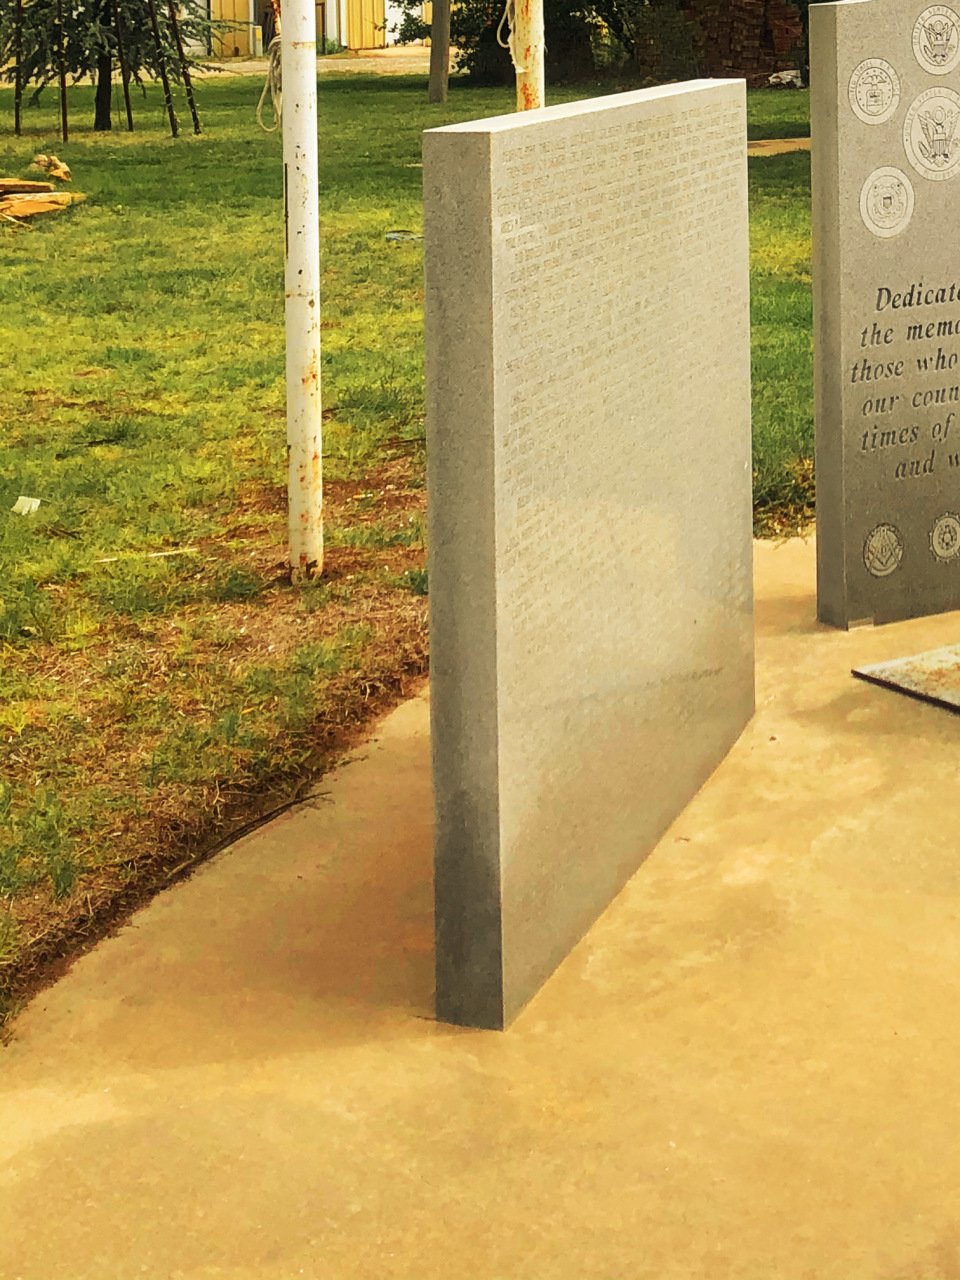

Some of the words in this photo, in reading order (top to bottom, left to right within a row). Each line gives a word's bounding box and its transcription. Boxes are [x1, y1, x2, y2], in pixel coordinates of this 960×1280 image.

[860, 323, 894, 348] the
[850, 358, 905, 384] those
[916, 347, 958, 371] who
[862, 396, 900, 417] our
[861, 424, 919, 452] times
[932, 412, 955, 442] of
[894, 449, 935, 480] and
